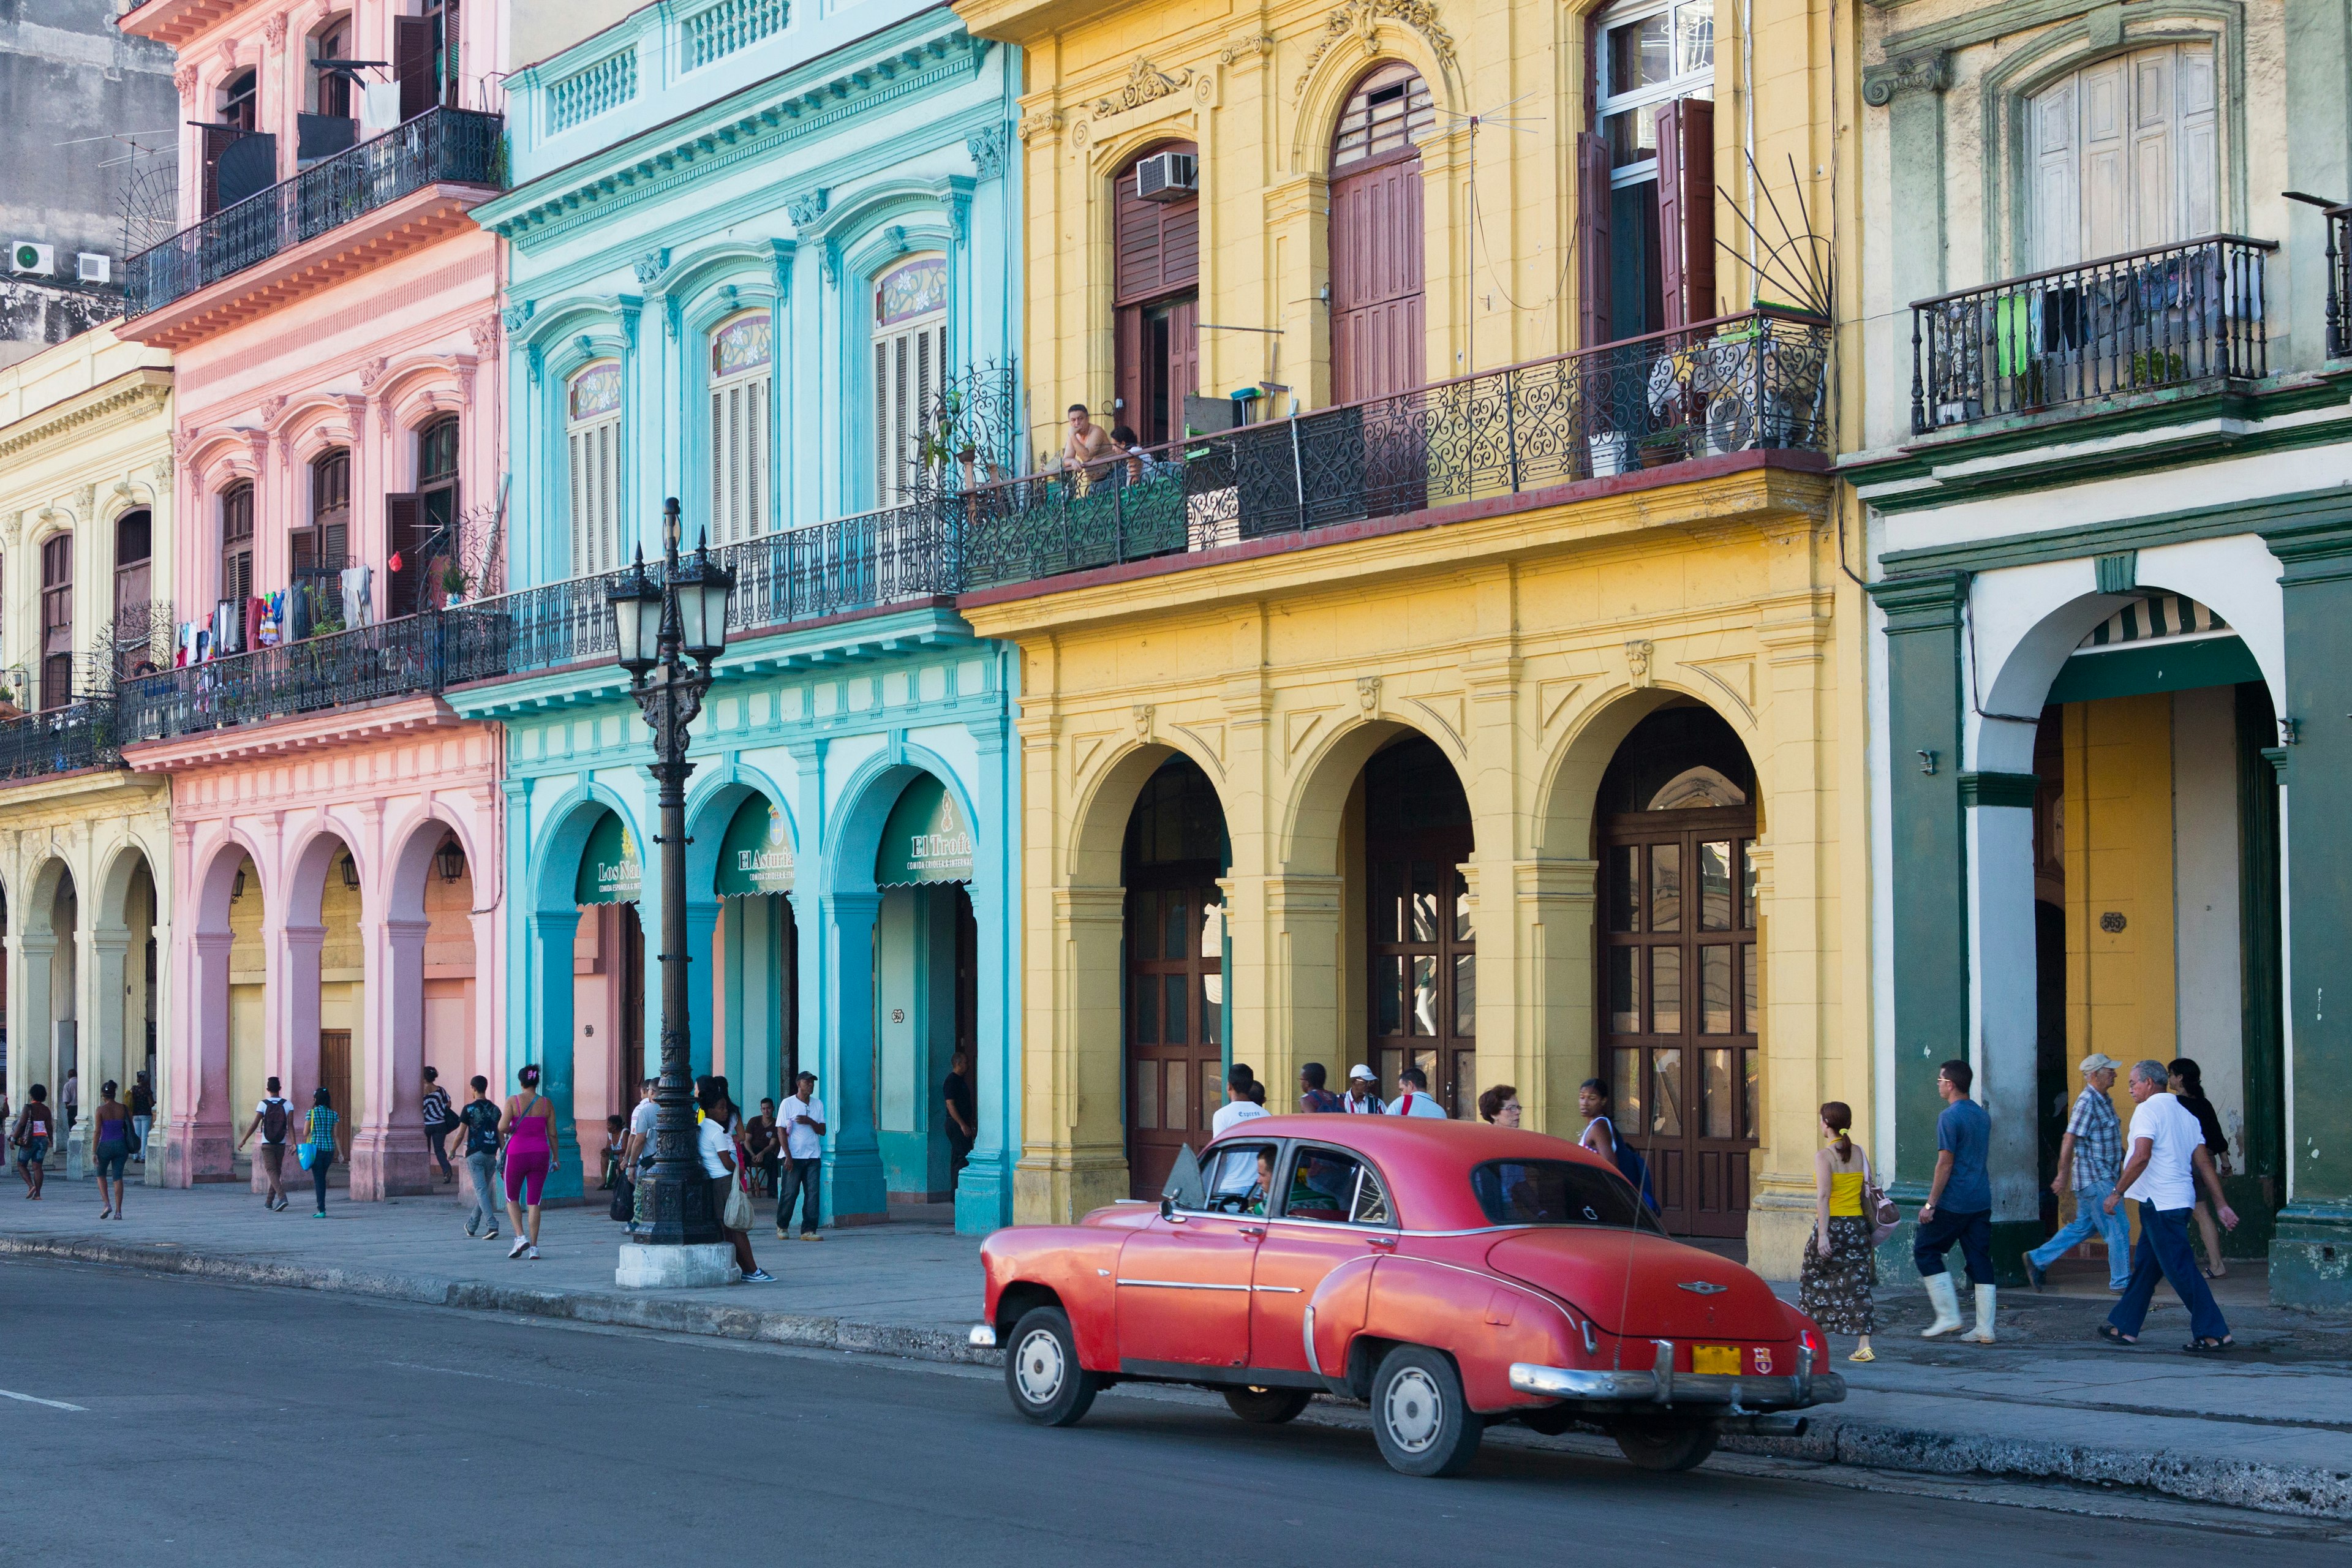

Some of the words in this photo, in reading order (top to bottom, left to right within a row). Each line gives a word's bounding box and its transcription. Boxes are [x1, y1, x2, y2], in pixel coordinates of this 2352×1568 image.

[911, 835, 928, 858] El
[930, 832, 971, 854] Trofe
[738, 850, 751, 870] El
[752, 847, 794, 869] Asturia
[907, 861, 925, 870] COMIDA
[925, 859, 944, 869] CRIOLLA
[598, 862, 619, 881] Los
[765, 872, 782, 880] CRIOLLA
[2105, 916, 2120, 928] 565
